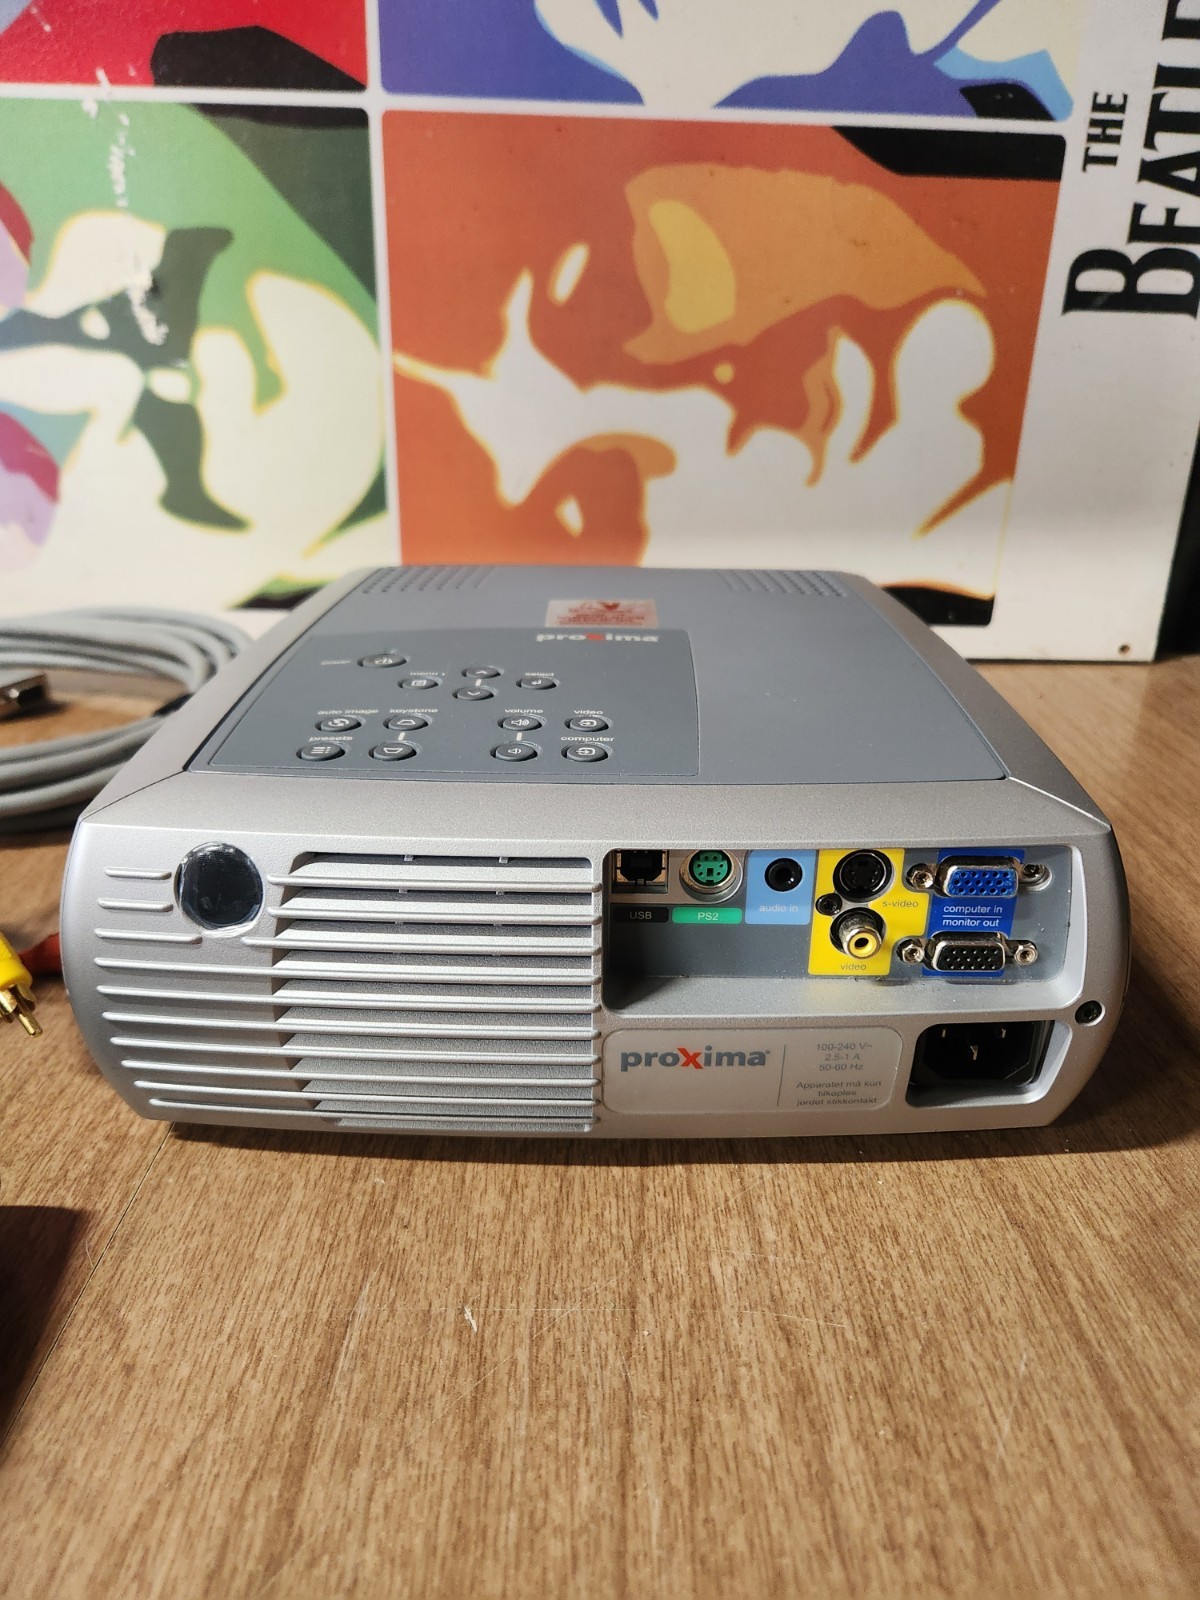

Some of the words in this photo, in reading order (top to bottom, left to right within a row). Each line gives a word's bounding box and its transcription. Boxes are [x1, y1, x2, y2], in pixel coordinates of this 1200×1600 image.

[1083, 91, 1128, 173] THE
[560, 735, 615, 743] computer
[758, 903, 787, 913] audio
[789, 904, 798, 913] in
[882, 900, 919, 908] s-video
[943, 905, 991, 914] computer
[993, 904, 1003, 913] in
[629, 911, 652, 920] USB
[697, 912, 719, 921] PS2
[942, 918, 981, 927] monitor
[983, 919, 999, 927] out
[840, 963, 867, 971] video
[816, 1042, 856, 1051] 100-240
[852, 1052, 861, 1060] A
[819, 1063, 847, 1071] 50-60
[796, 1081, 844, 1090] Apparatet
[863, 1080, 882, 1088] kun
